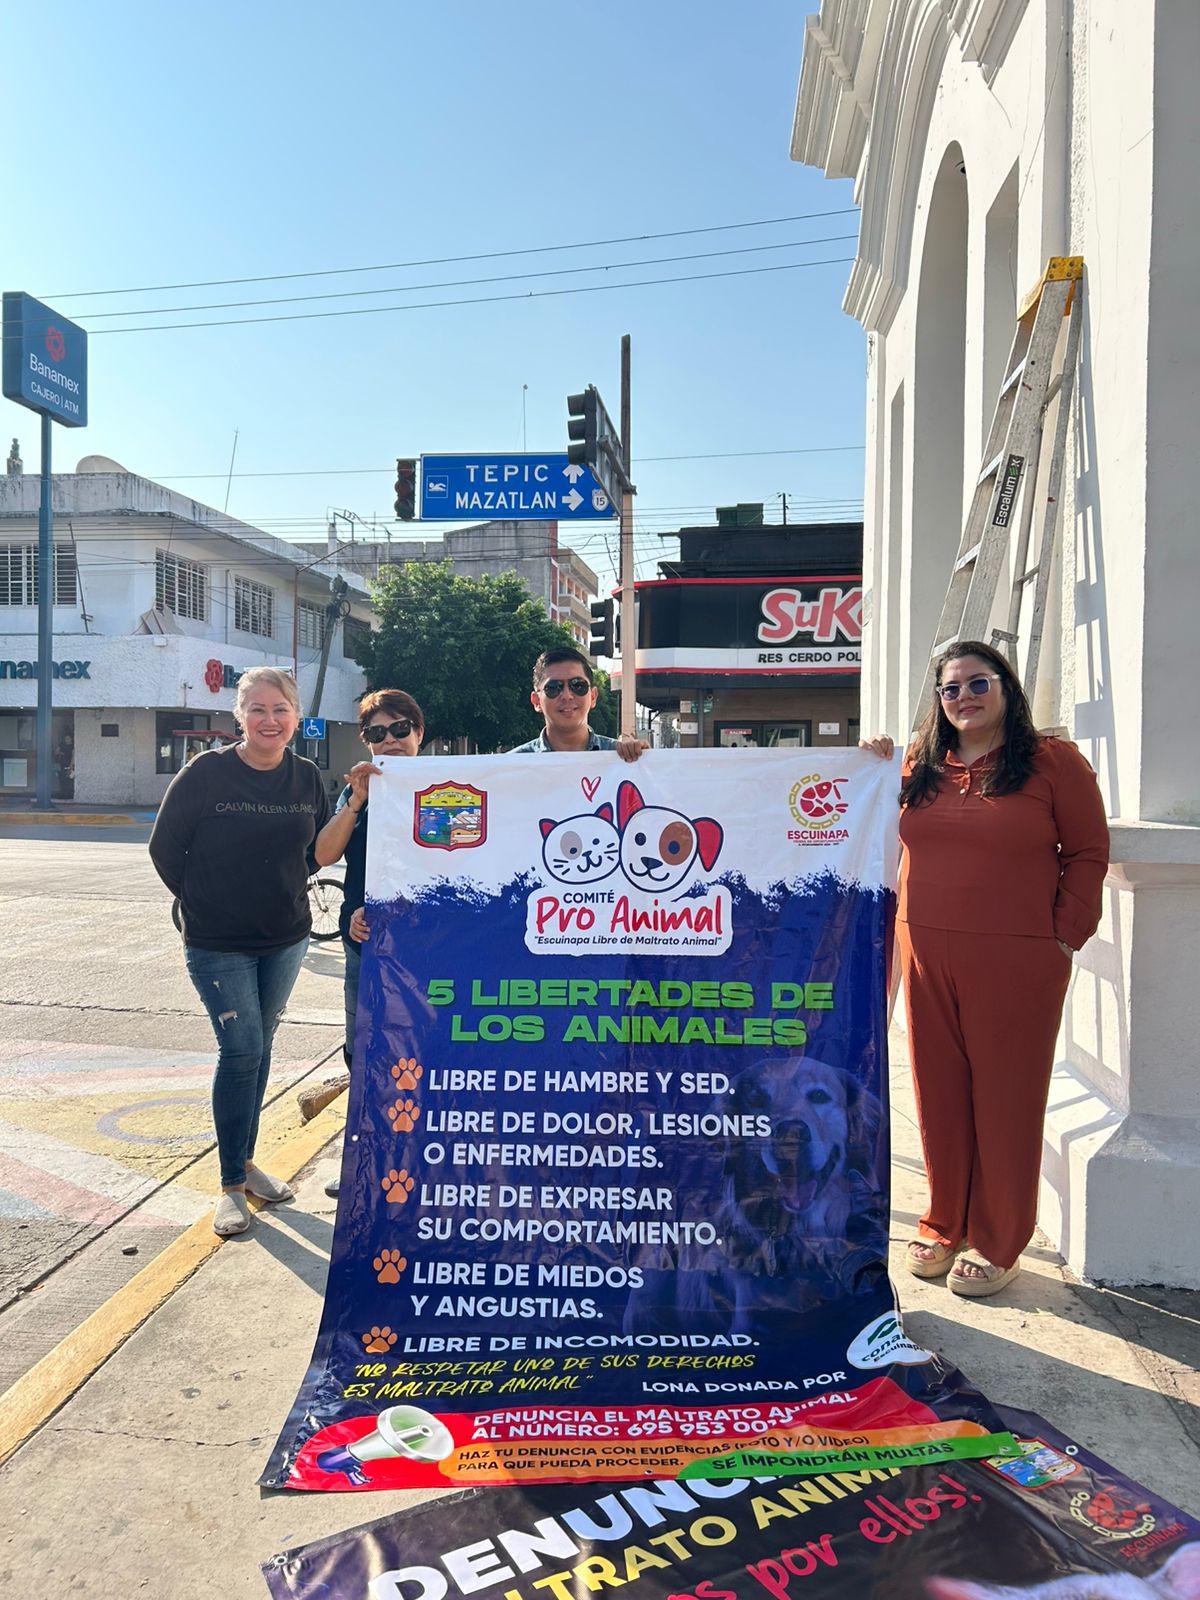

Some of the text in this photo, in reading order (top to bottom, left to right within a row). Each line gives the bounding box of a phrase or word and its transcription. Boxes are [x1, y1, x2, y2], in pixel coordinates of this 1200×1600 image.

[30, 353, 79, 394] Banamex
[31, 382, 79, 415] CAJERO ATM
[465, 464, 549, 482] TEPIC
[455, 491, 556, 509] MAZATLAN
[596, 496, 606, 506] 15
[758, 653, 783, 663] RES
[788, 652, 832, 662] CERDO
[215, 802, 256, 813] CALVIN
[257, 804, 288, 814] KLEIN
[787, 829, 849, 840] ESCUINAPA
[563, 889, 615, 904] COMITÉ
[536, 895, 723, 935] Pro Animal
[534, 935, 722, 946] "Escuinapa Libre de Maltrato Animal"
[427, 979, 834, 1009] 5 LIBERTADES DE
[451, 1014, 808, 1046] LOS ANIMALES
[428, 1069, 736, 1095] LIBRE DE HAMBRE Y SED.
[425, 1110, 772, 1139] LIBRE DE DOLOR, LESIONES
[423, 1142, 664, 1169] O ENFERMEDADES.
[420, 1184, 673, 1211] LIBRE DE EXPRESAR
[417, 1217, 722, 1245] SU COMPORTAMIENTO.
[412, 1262, 644, 1289] LIBRE DE MIEDOS
[410, 1295, 604, 1319] Y ANGUSTIAS.
[403, 1334, 760, 1353] LIBRE DE INCOMODIDAD.
[391, 1359, 508, 1378] RESPETAR
[513, 1357, 555, 1373] UNO
[562, 1356, 595, 1371] DE
[600, 1354, 640, 1368] SUS
[647, 1354, 756, 1370] DERECHOS
[343, 1383, 377, 1399] ES
[375, 1379, 494, 1399] MALTRATO
[642, 1370, 848, 1393] LONA DONADA POR
[473, 1409, 598, 1426] DENUNCIA
[604, 1410, 630, 1422] EL
[636, 1408, 761, 1423] MALTRATO
[472, 1425, 501, 1440] AL
[509, 1421, 619, 1437] NÚMERO:
[627, 1421, 673, 1437] 695
[679, 1422, 726, 1436] 953
[459, 1450, 490, 1460] HAZ
[494, 1448, 514, 1456] TU
[517, 1447, 595, 1457] DENUNCIA
[601, 1446, 636, 1455] CON
[640, 1443, 731, 1455] EVIDENCIAS
[712, 1443, 954, 1470] SE IMPONDRÁN MULTAS
[458, 1457, 684, 1471] PARA QUE PUEDA PROCEDER.
[858, 1474, 982, 1544] ellos!
